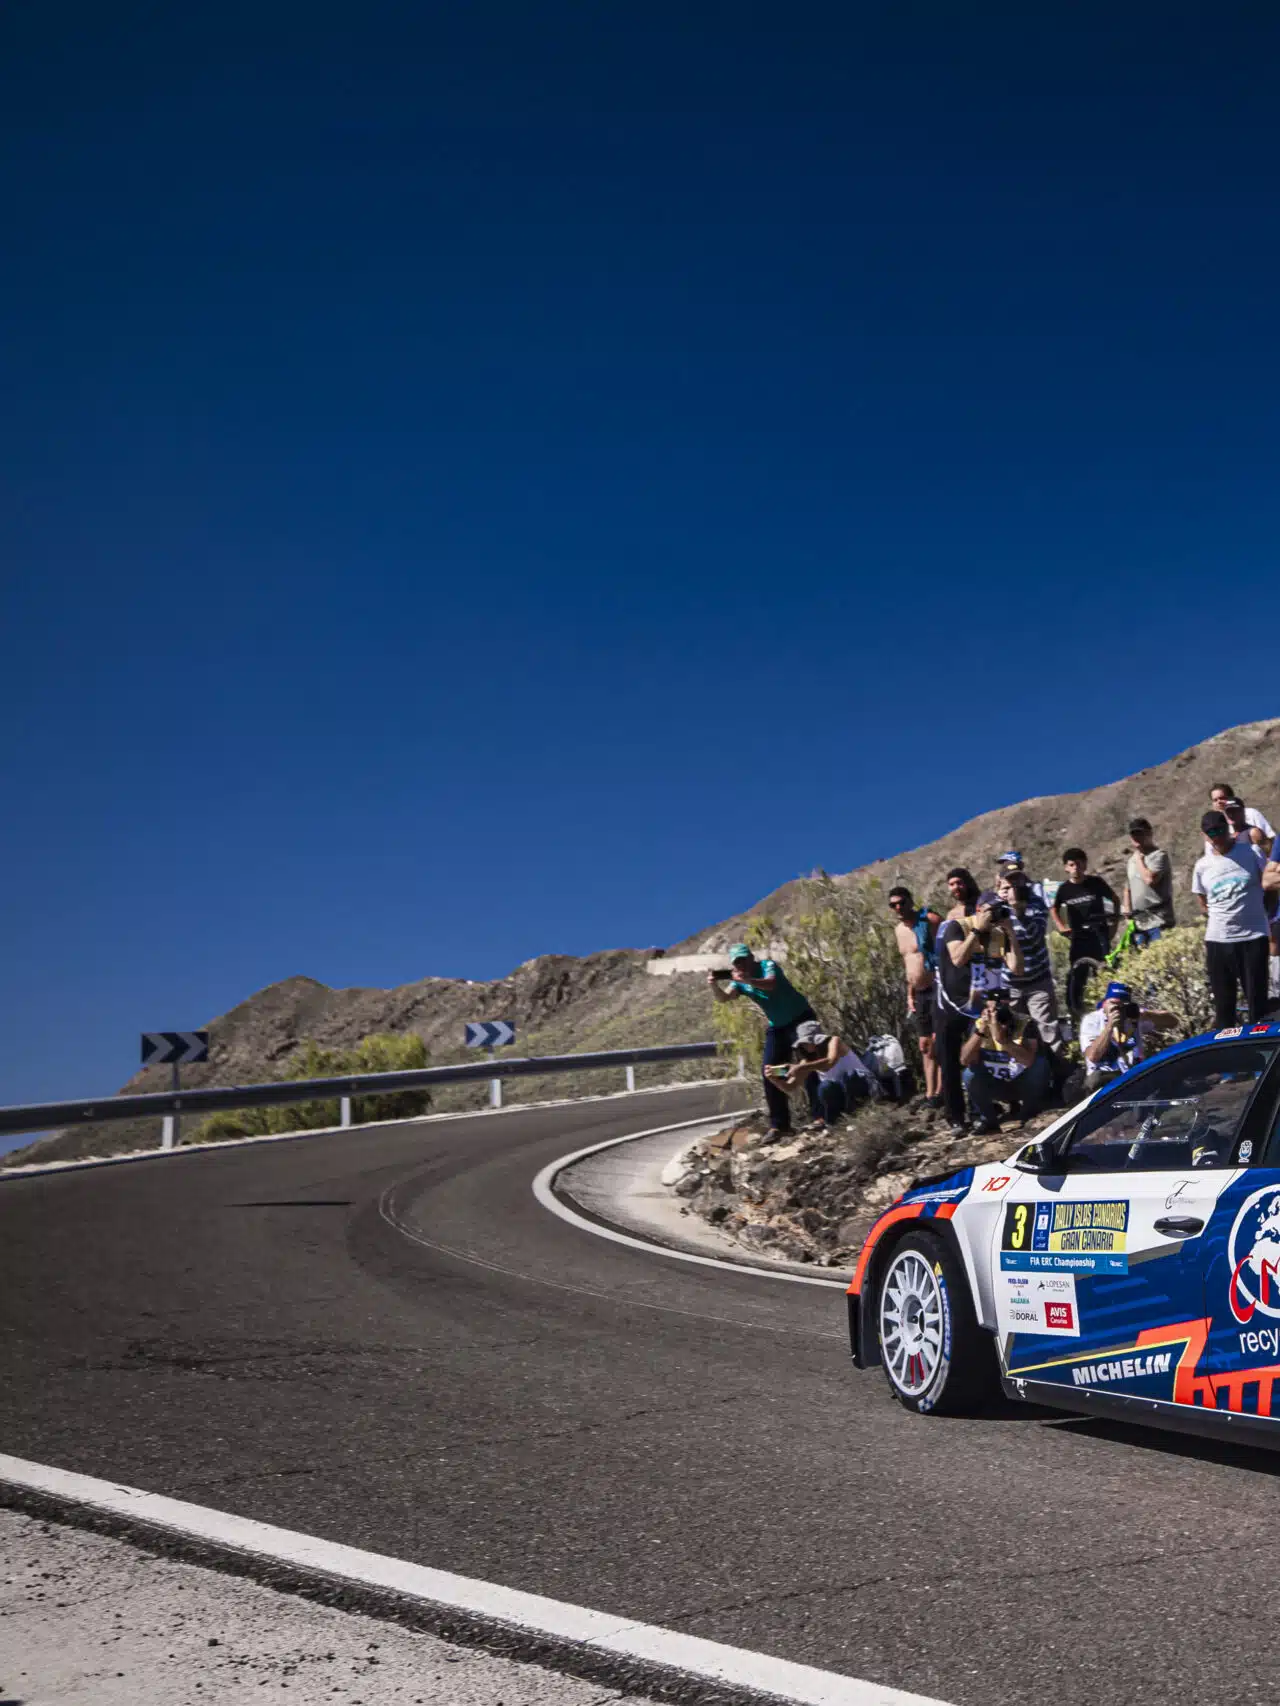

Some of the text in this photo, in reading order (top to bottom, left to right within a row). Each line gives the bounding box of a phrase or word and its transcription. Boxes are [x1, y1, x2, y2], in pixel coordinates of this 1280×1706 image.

[1054, 1204, 1074, 1230] RALLY
[1074, 1203, 1092, 1227] ISLAS
[1092, 1203, 1126, 1230] CANARIAS
[1011, 1205, 1028, 1249] 3
[1061, 1231, 1081, 1250] GRAN
[1082, 1230, 1114, 1250] CANARIA
[1030, 1257, 1096, 1269] FIA ERC Championship
[1046, 1280, 1070, 1288] LOPESAN
[1016, 1312, 1038, 1321] DORAL
[1050, 1307, 1067, 1317] AVIS
[1072, 1353, 1172, 1385] MICHELIN
